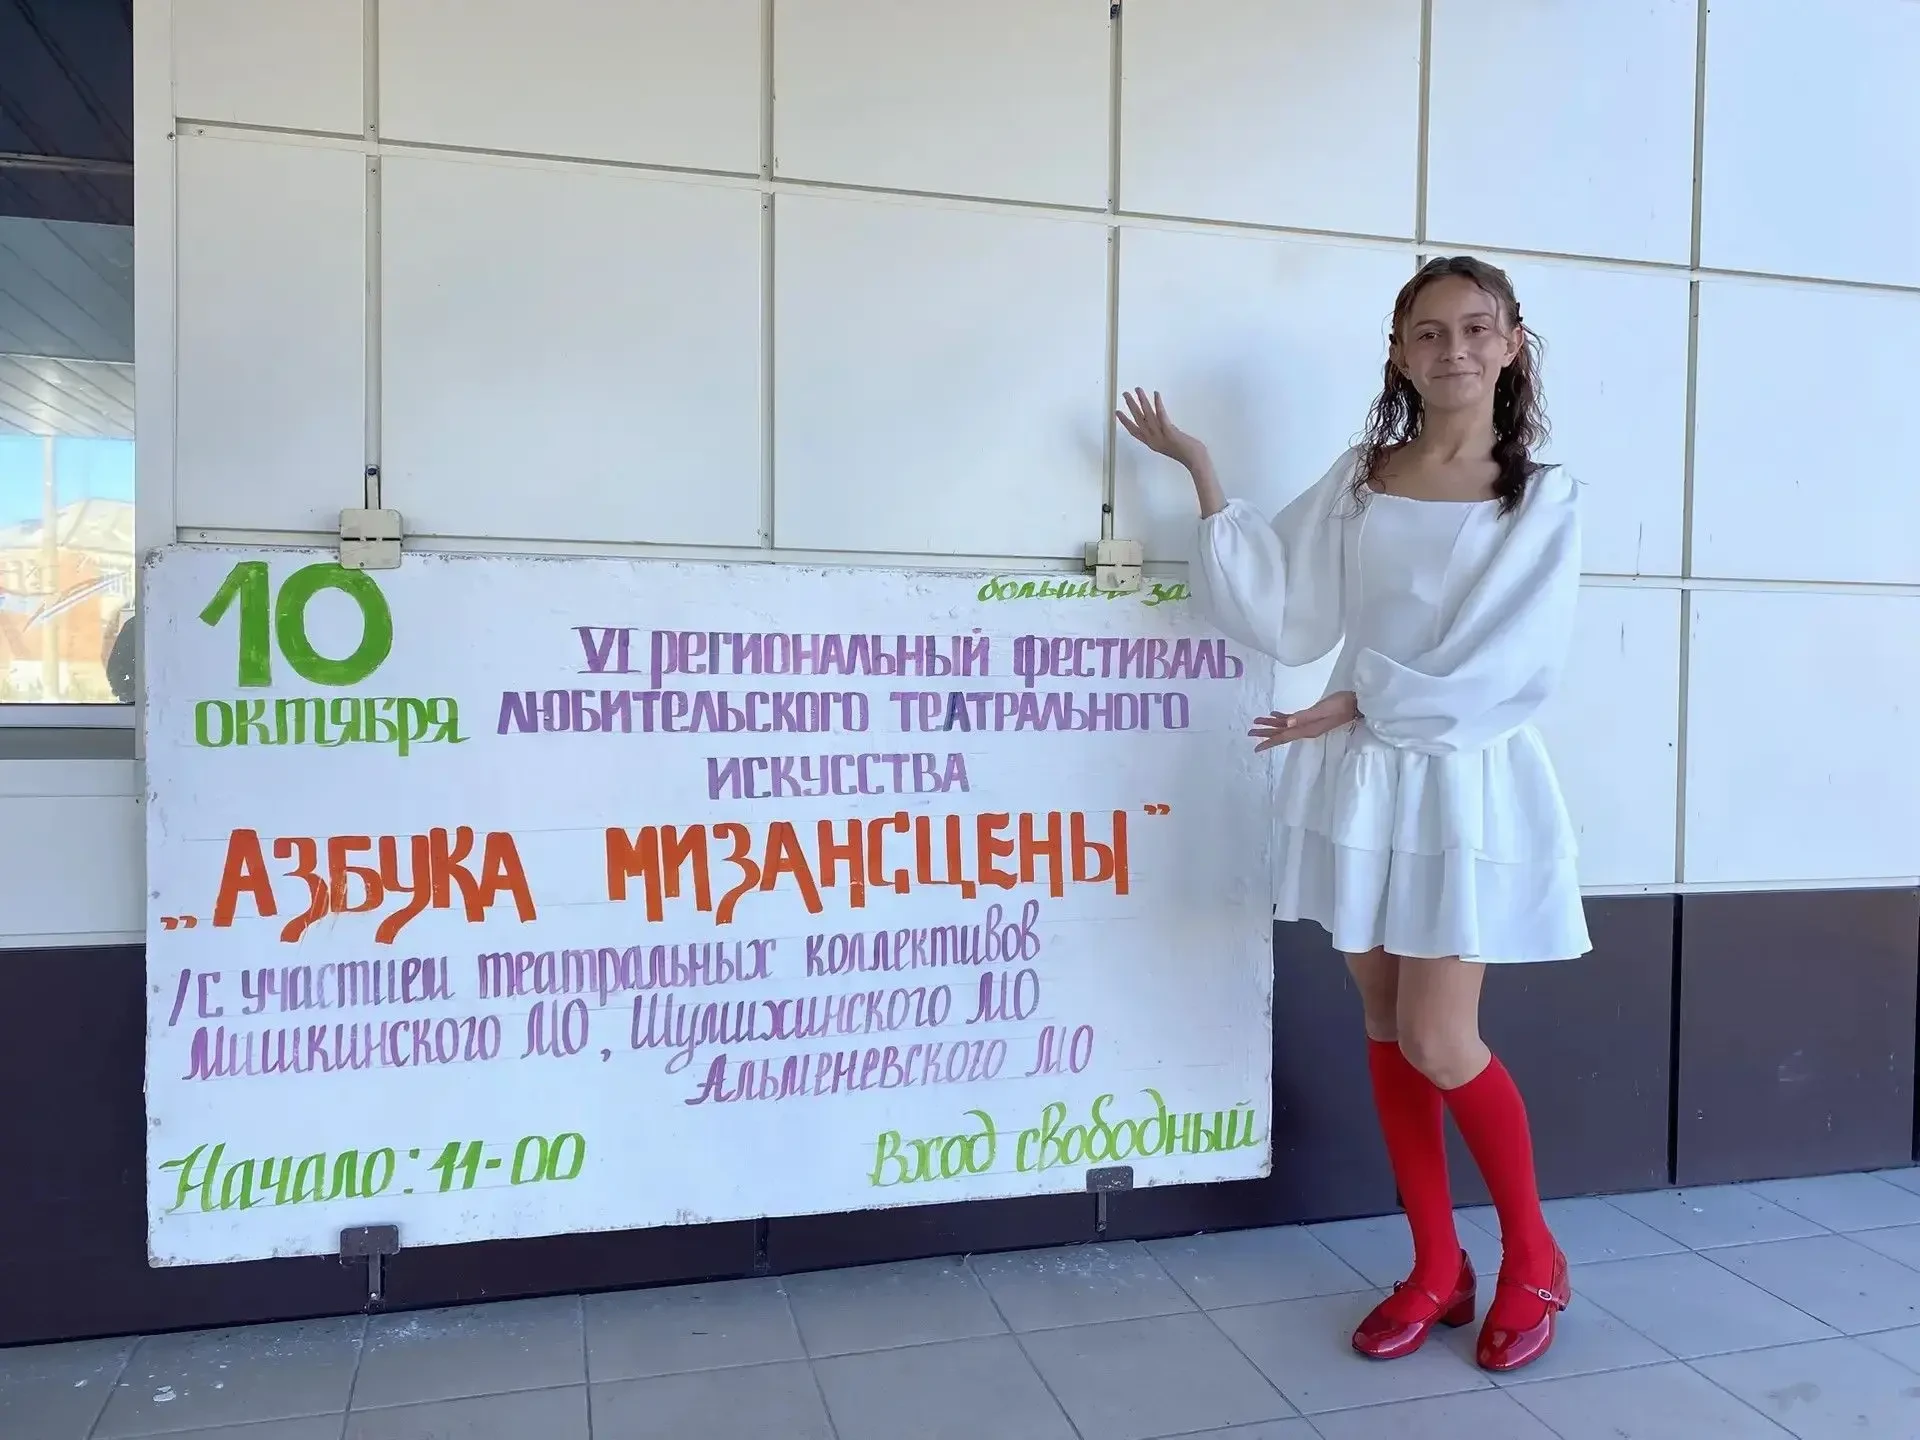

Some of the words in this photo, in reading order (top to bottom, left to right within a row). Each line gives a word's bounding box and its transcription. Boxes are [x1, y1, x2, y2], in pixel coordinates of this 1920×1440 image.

[199, 561, 393, 687] 10
[1141, 583, 1192, 606] за
[571, 626, 641, 674] VI
[195, 697, 471, 757] октября
[498, 689, 868, 734] ЛЮБИТЕЛЬСКОГО
[890, 691, 1189, 733] ТЕАТРАЛЬНОГО
[707, 753, 970, 800] ИСКУССТВА
[242, 954, 455, 1014] участием
[478, 937, 776, 1006] театральных
[806, 899, 1041, 977] коллективов
[182, 1013, 501, 1080] Мишкинского
[630, 984, 951, 1074] Шумихинского
[966, 968, 1041, 1024] МО
[685, 1039, 1007, 1105] Альменевского
[1025, 1024, 1093, 1077] МО
[159, 1142, 420, 1214] Начало:
[427, 1132, 586, 1193] 11-00
[868, 1110, 996, 1186] Вход
[1016, 1088, 1263, 1172] свободный
